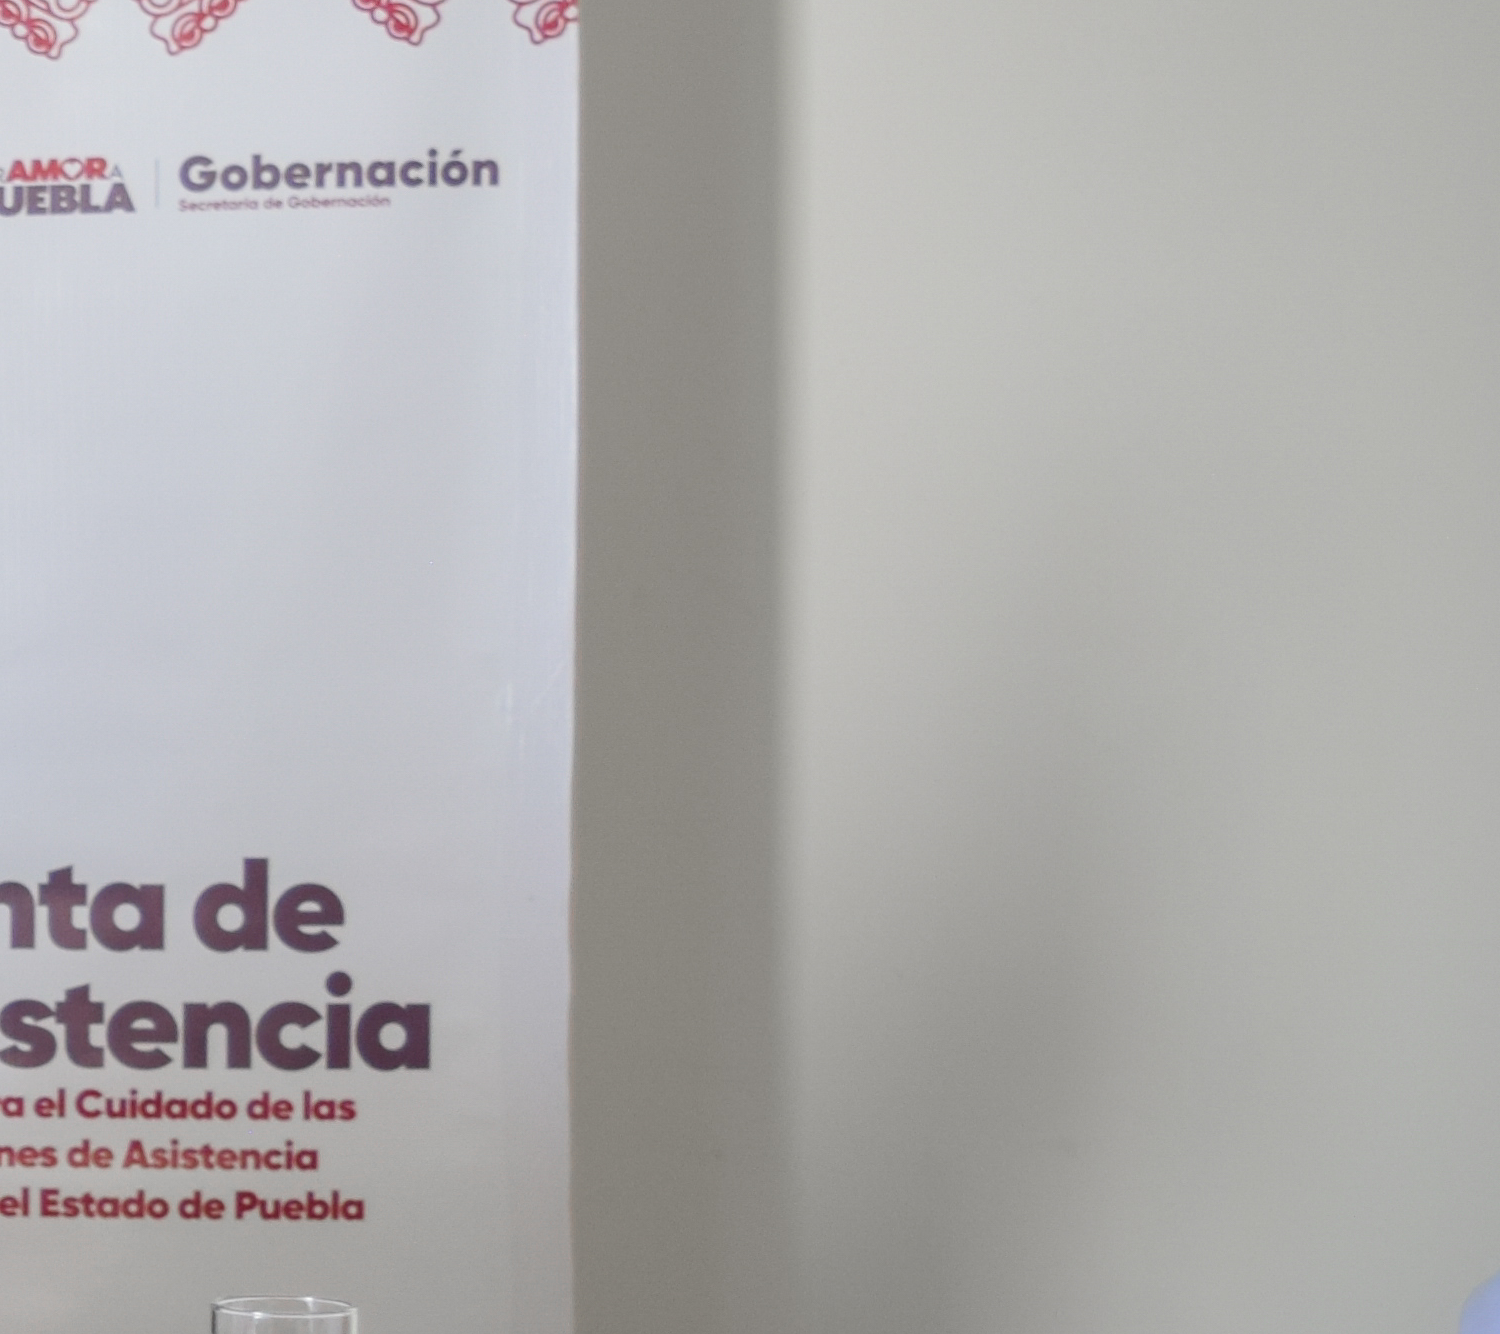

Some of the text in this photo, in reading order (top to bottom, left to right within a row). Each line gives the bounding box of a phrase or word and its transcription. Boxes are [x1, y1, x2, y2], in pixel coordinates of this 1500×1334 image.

[6, 157, 107, 182] AMOR
[179, 148, 499, 192] Gobernación
[263, 197, 283, 210] de
[192, 857, 345, 953] de
[34, 1089, 66, 1119] el
[75, 1089, 237, 1121] Cuidado
[246, 1091, 294, 1121] de
[303, 1091, 357, 1122] las
[68, 1138, 113, 1168] de
[121, 1139, 318, 1171] Asistencia
[39, 1189, 169, 1219] Estado
[178, 1190, 225, 1219] de
[235, 1191, 365, 1221] Puebla
